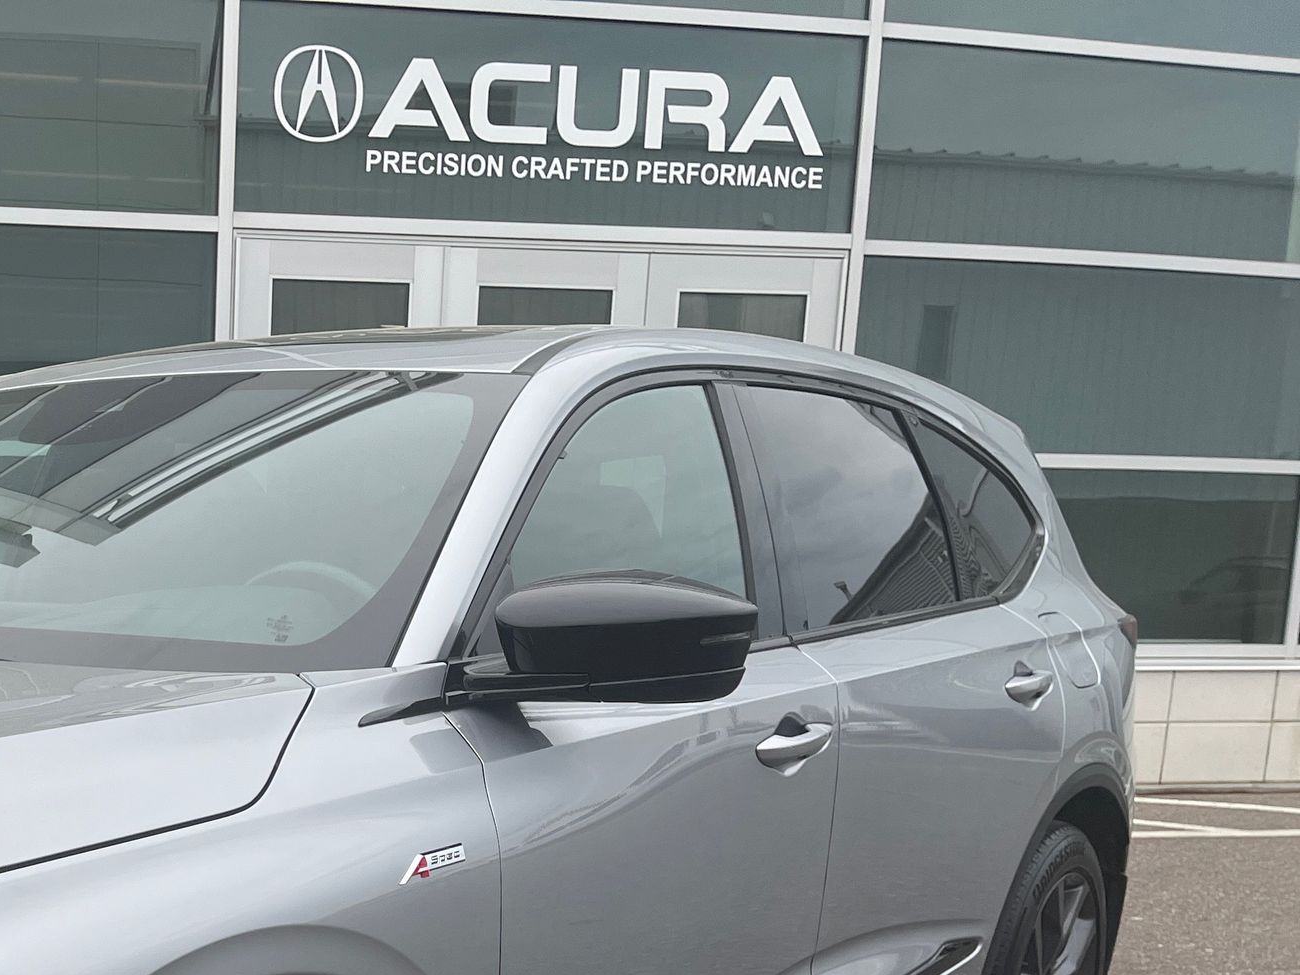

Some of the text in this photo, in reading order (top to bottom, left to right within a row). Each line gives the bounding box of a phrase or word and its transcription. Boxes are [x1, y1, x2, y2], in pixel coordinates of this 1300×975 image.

[367, 57, 824, 157] ACURA
[364, 149, 824, 189] PRECISION CRAFTED PERFORMANCE
[1032, 841, 1088, 900] BRIDGESTO
